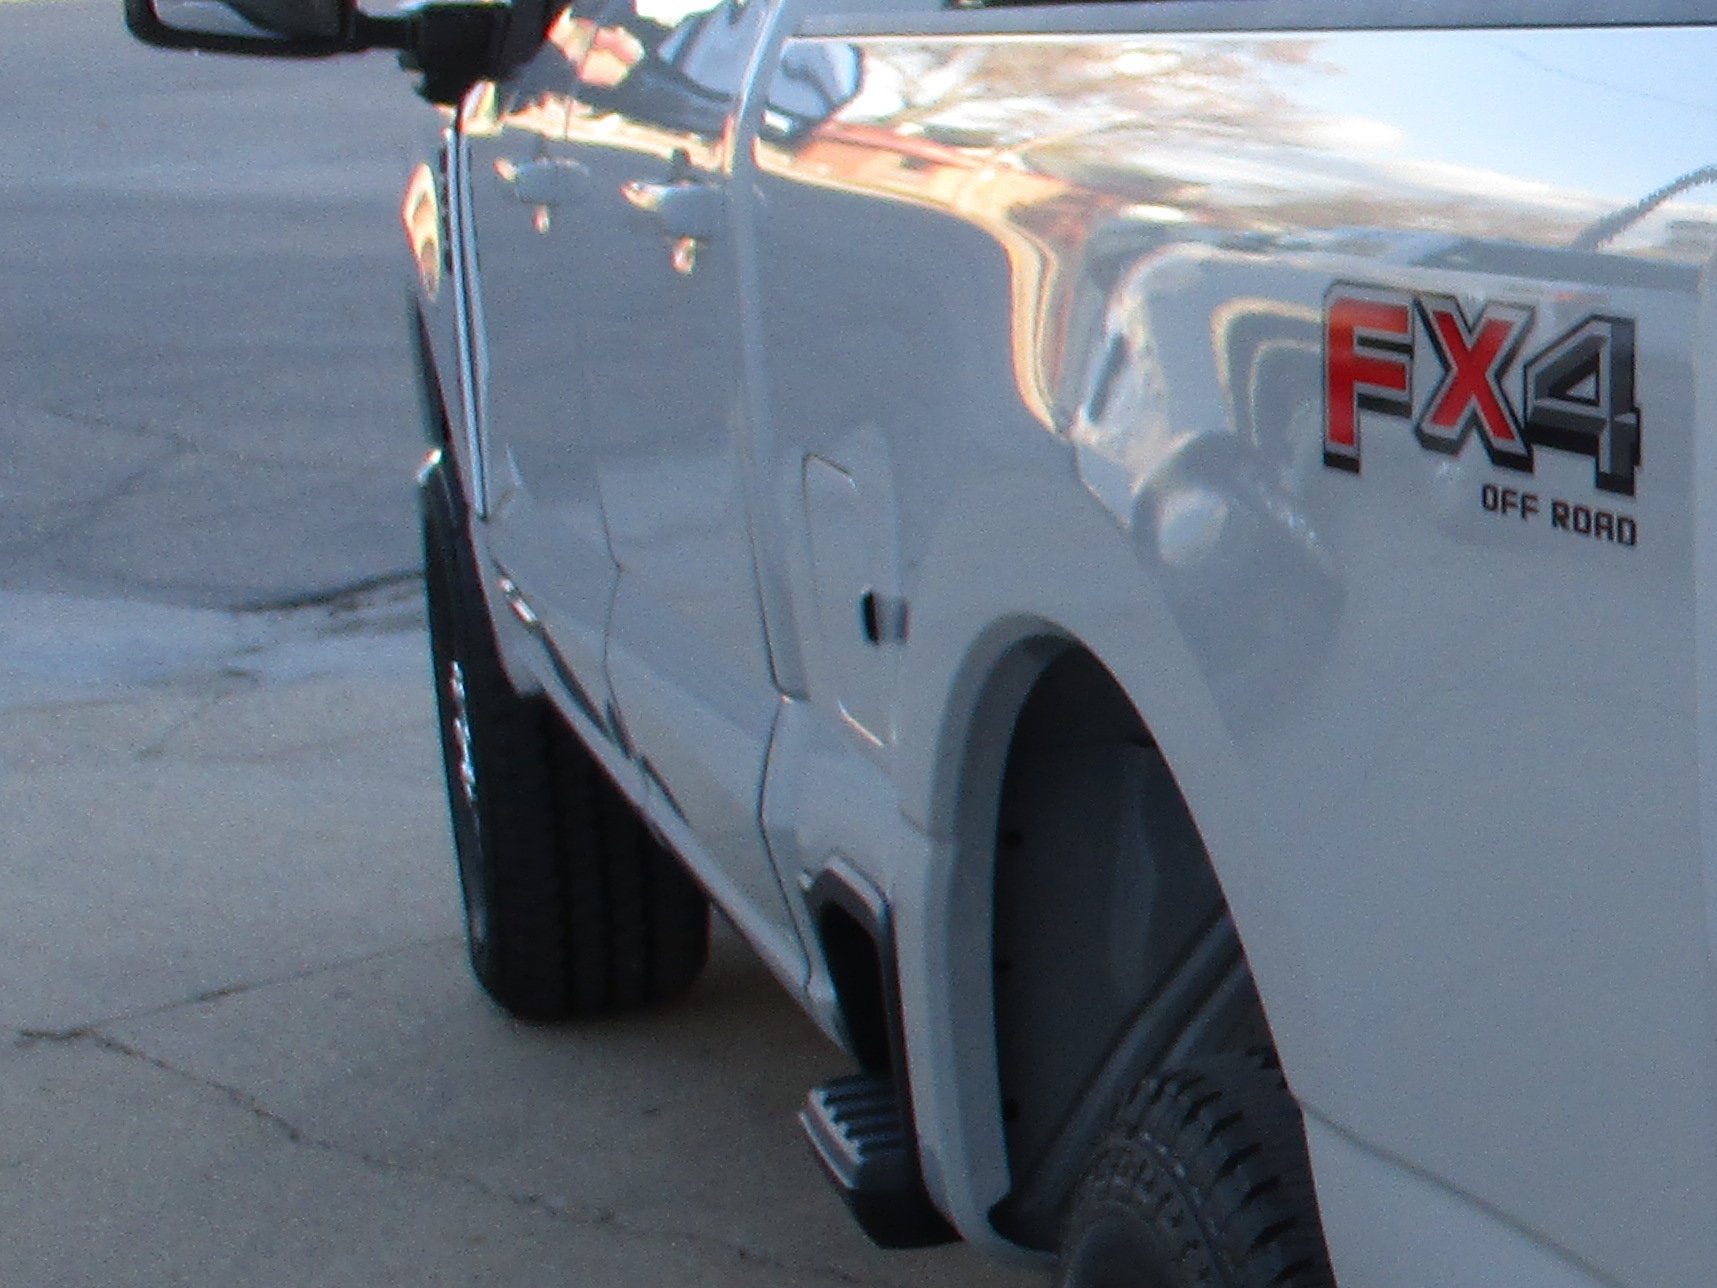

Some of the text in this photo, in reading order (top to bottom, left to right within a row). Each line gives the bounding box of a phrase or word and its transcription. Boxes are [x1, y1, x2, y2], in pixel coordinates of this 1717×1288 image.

[1323, 280, 1641, 496] FX4
[1481, 483, 1638, 546] OFF ROAD
